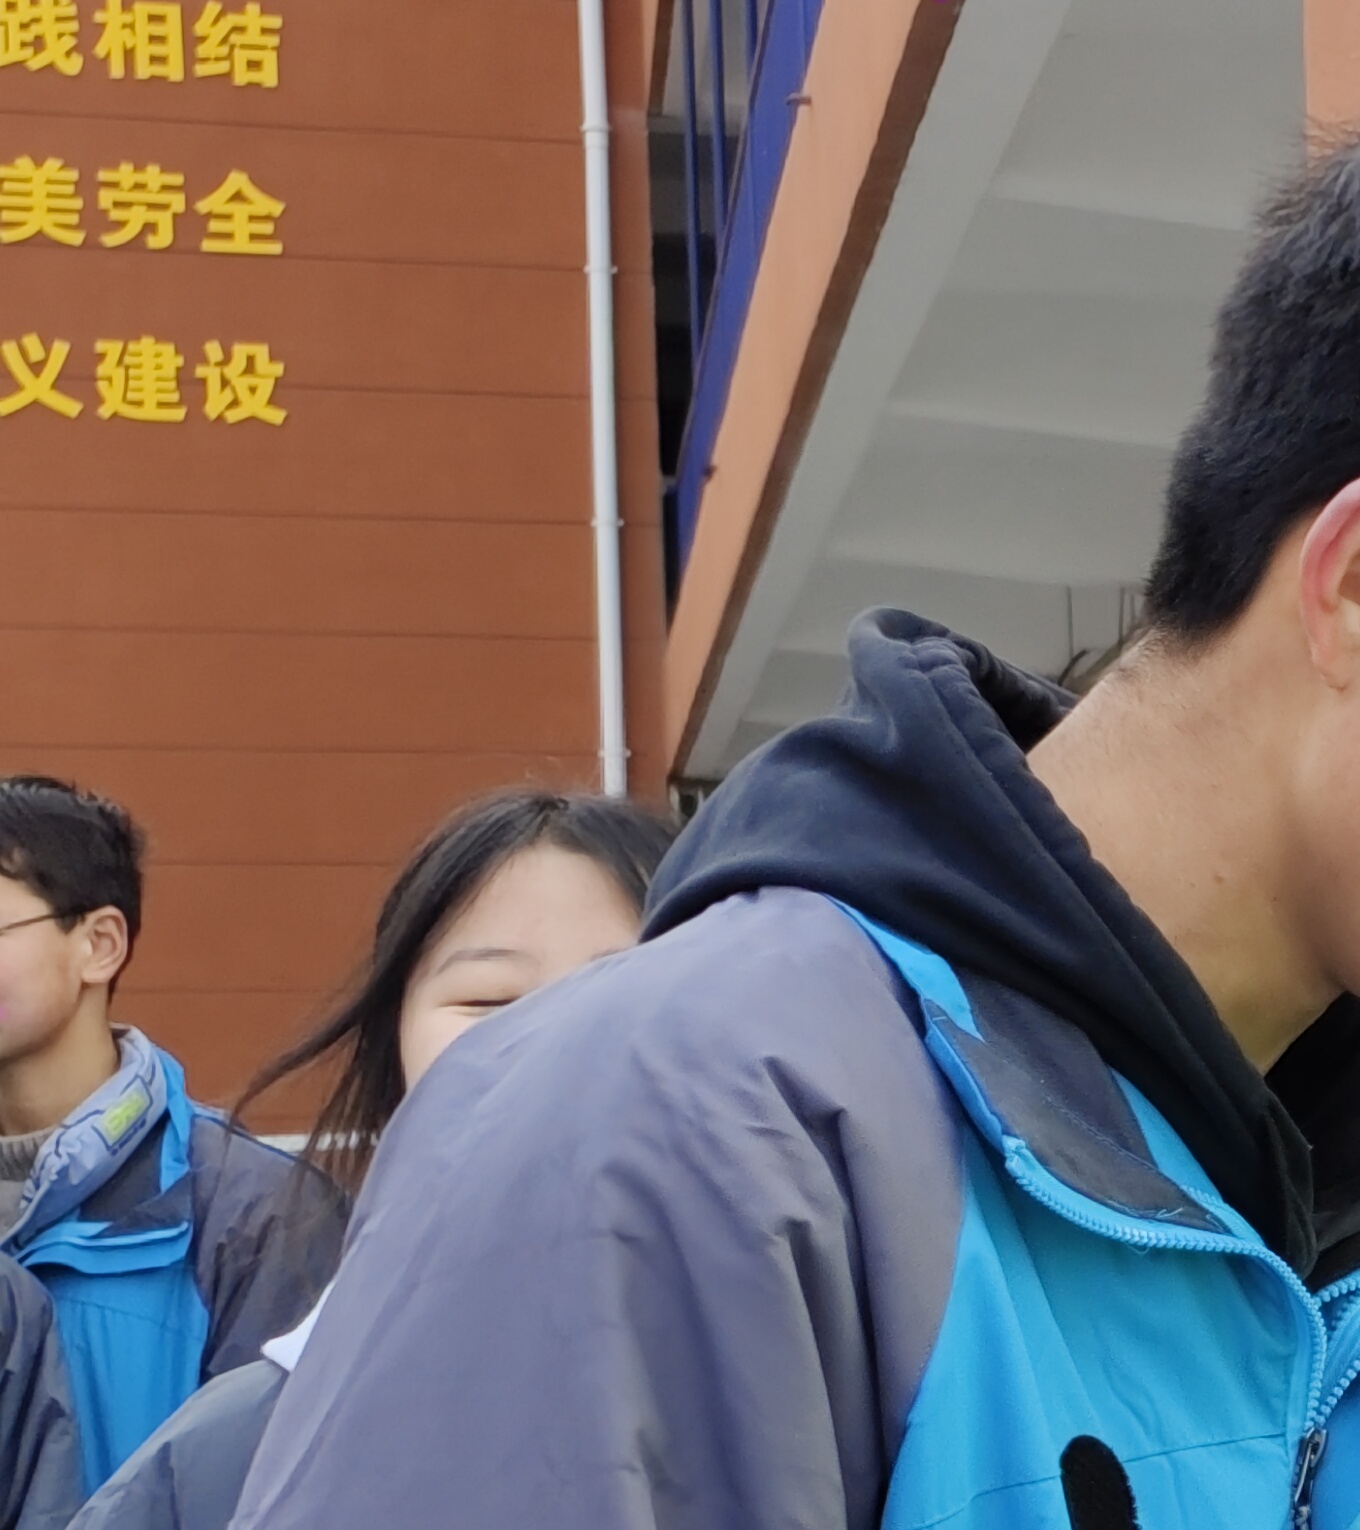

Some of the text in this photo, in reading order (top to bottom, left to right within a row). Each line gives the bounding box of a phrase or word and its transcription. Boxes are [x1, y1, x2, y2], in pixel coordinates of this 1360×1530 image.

[0, 0, 284, 88] 践相结
[0, 155, 286, 255] 美劳全
[0, 332, 287, 425] 义建设
